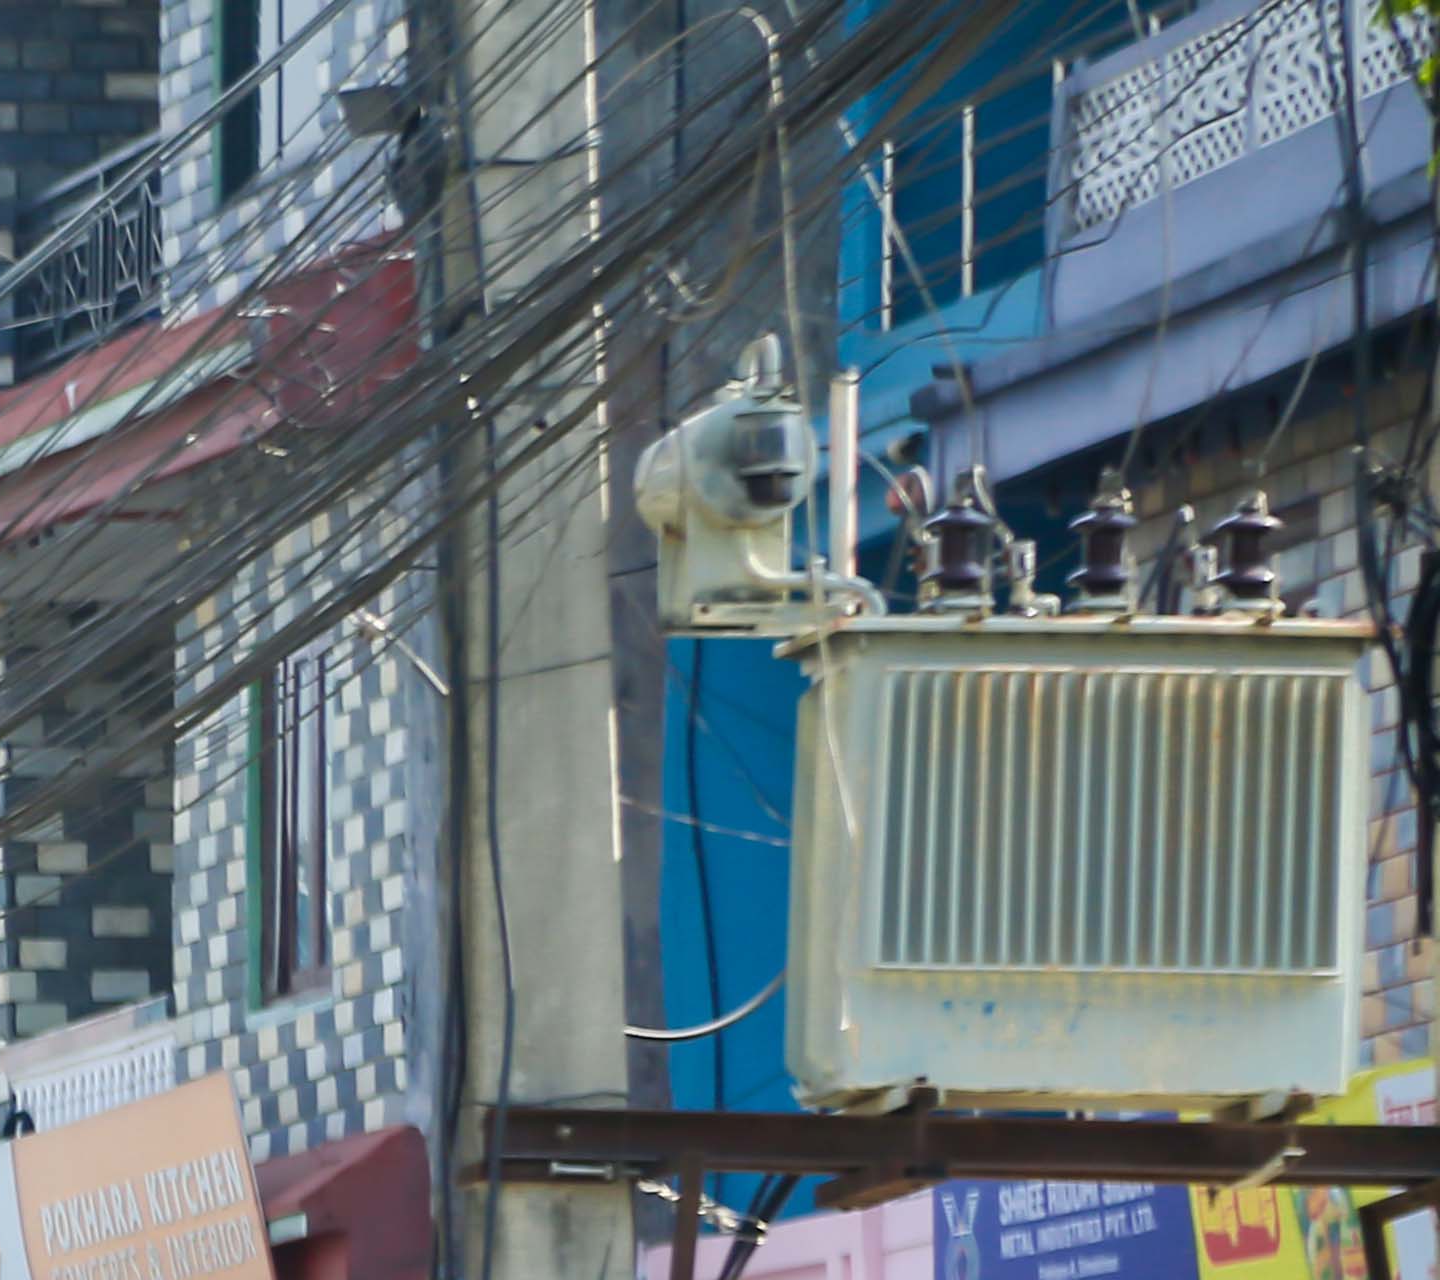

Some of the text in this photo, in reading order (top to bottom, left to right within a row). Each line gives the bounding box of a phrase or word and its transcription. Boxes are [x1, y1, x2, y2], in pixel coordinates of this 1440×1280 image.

[40, 1147, 247, 1257] POKHARA KITCHEN
[165, 1214, 257, 1280] INTERIOR
